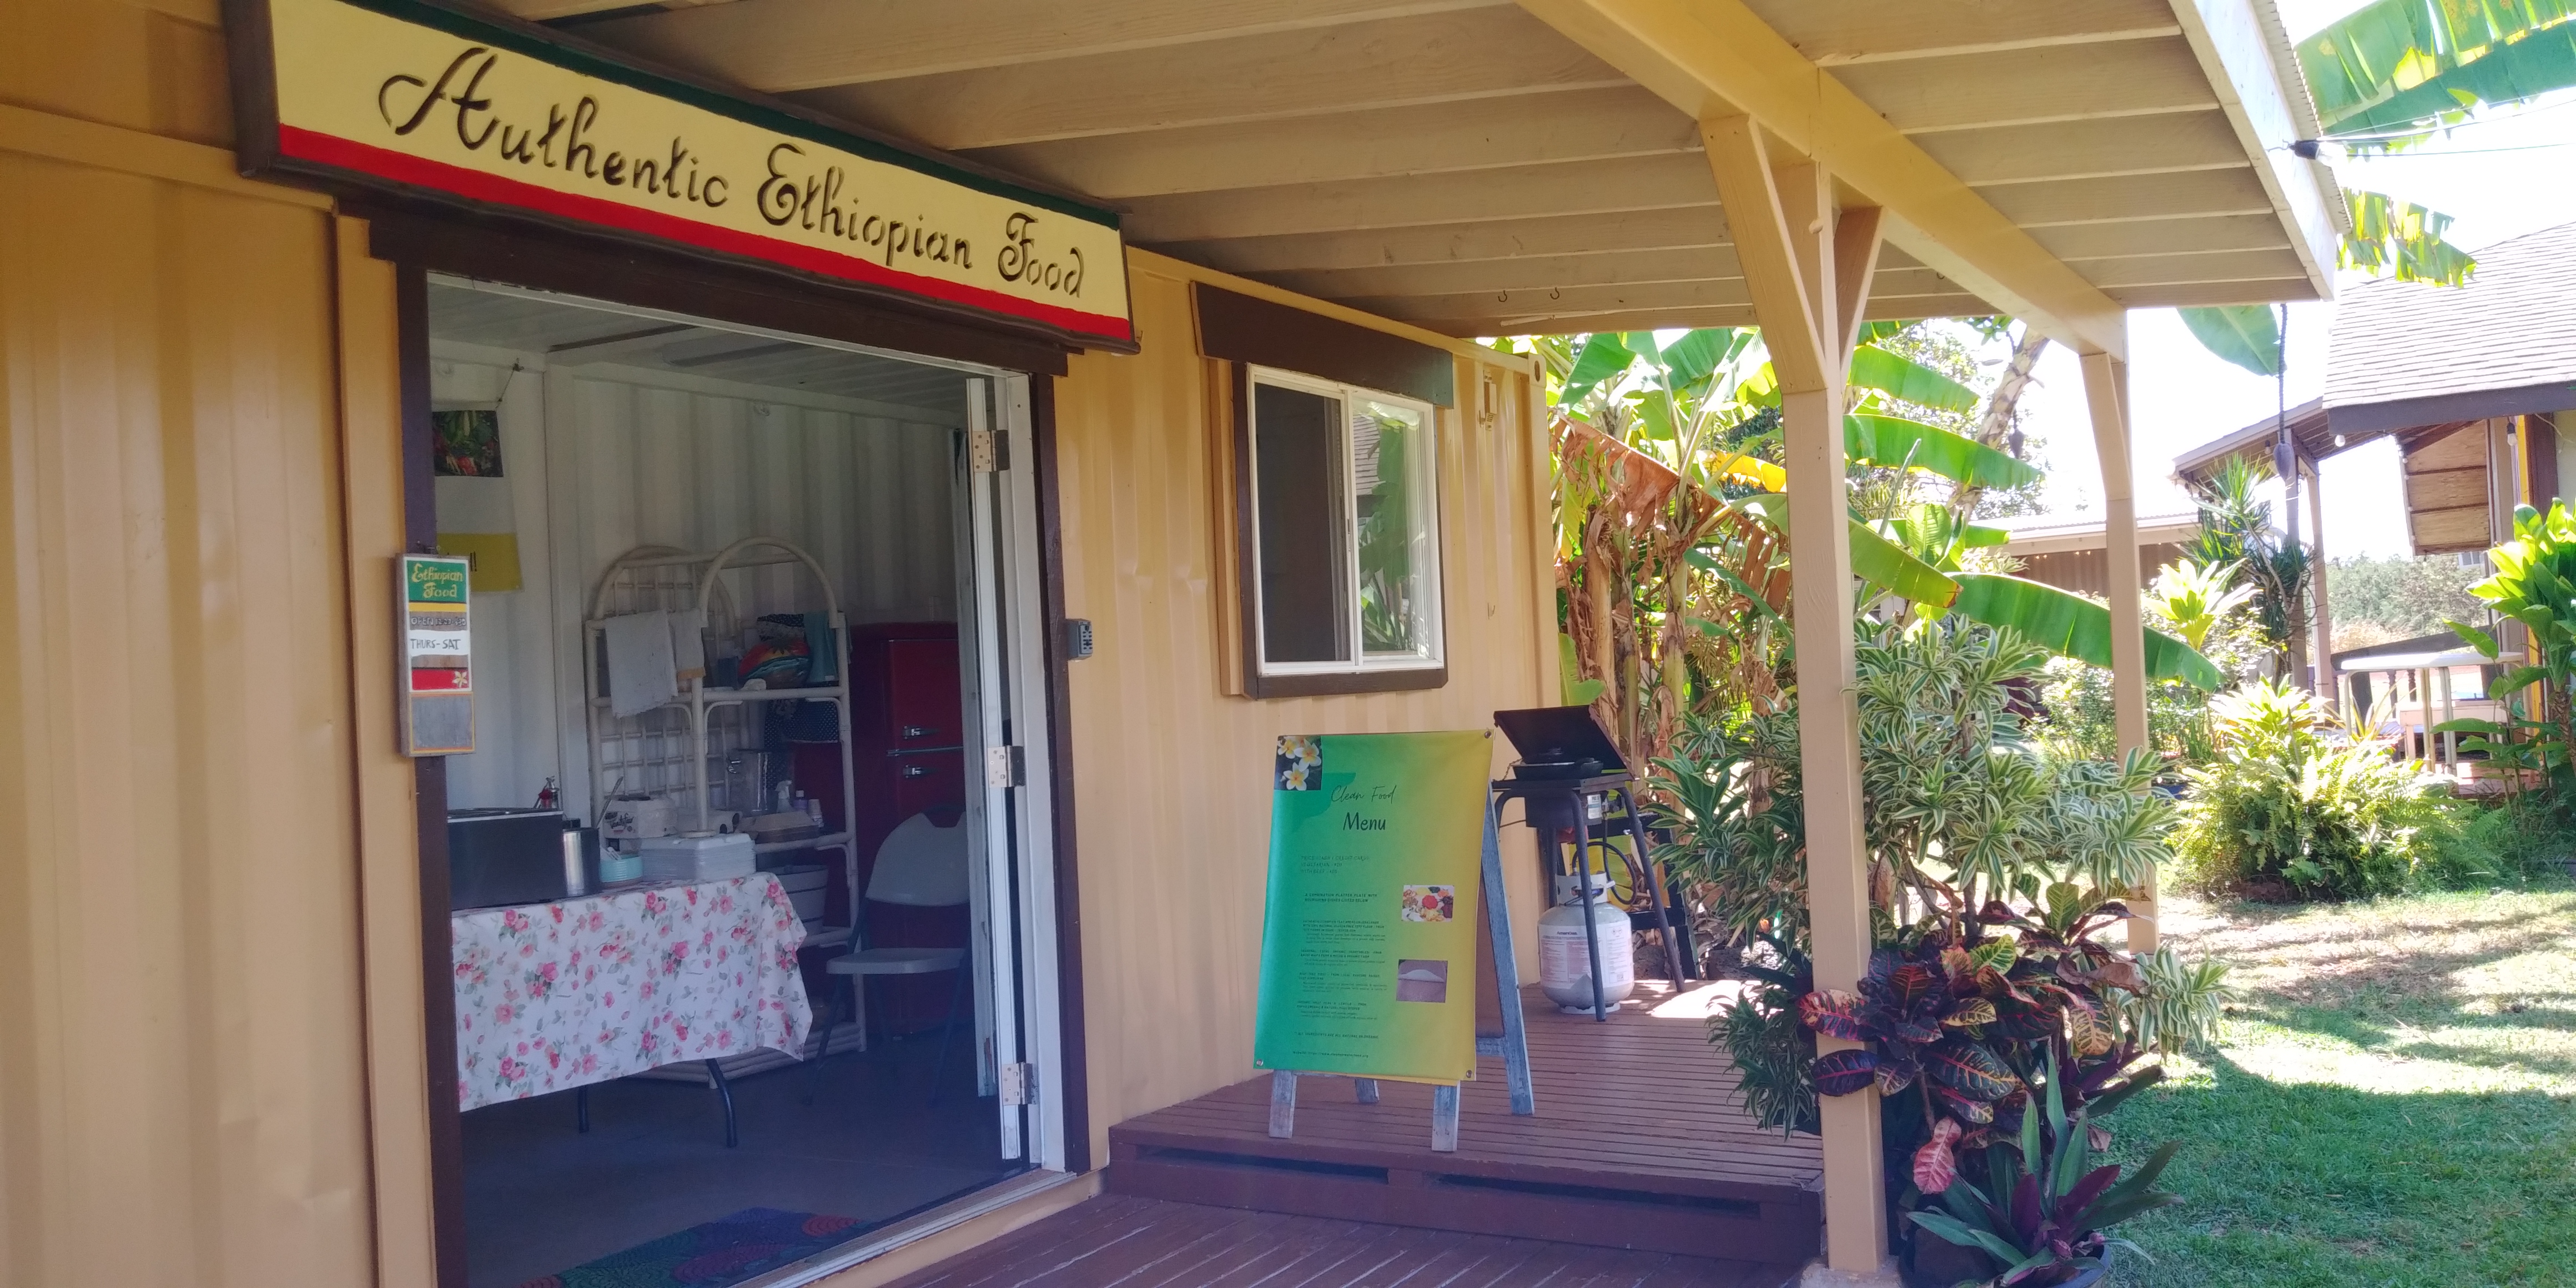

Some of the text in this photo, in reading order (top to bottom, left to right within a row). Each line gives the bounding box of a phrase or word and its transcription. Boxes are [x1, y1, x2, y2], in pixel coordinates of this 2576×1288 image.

[377, 47, 1085, 299] Authentic Ethiopian Food
[411, 562, 464, 585] Ethiopian
[423, 582, 458, 599] Food
[411, 617, 435, 626] OPEN
[442, 638, 461, 650] SAT
[1331, 784, 1397, 804] Clean Food
[1342, 812, 1387, 832] Menu
